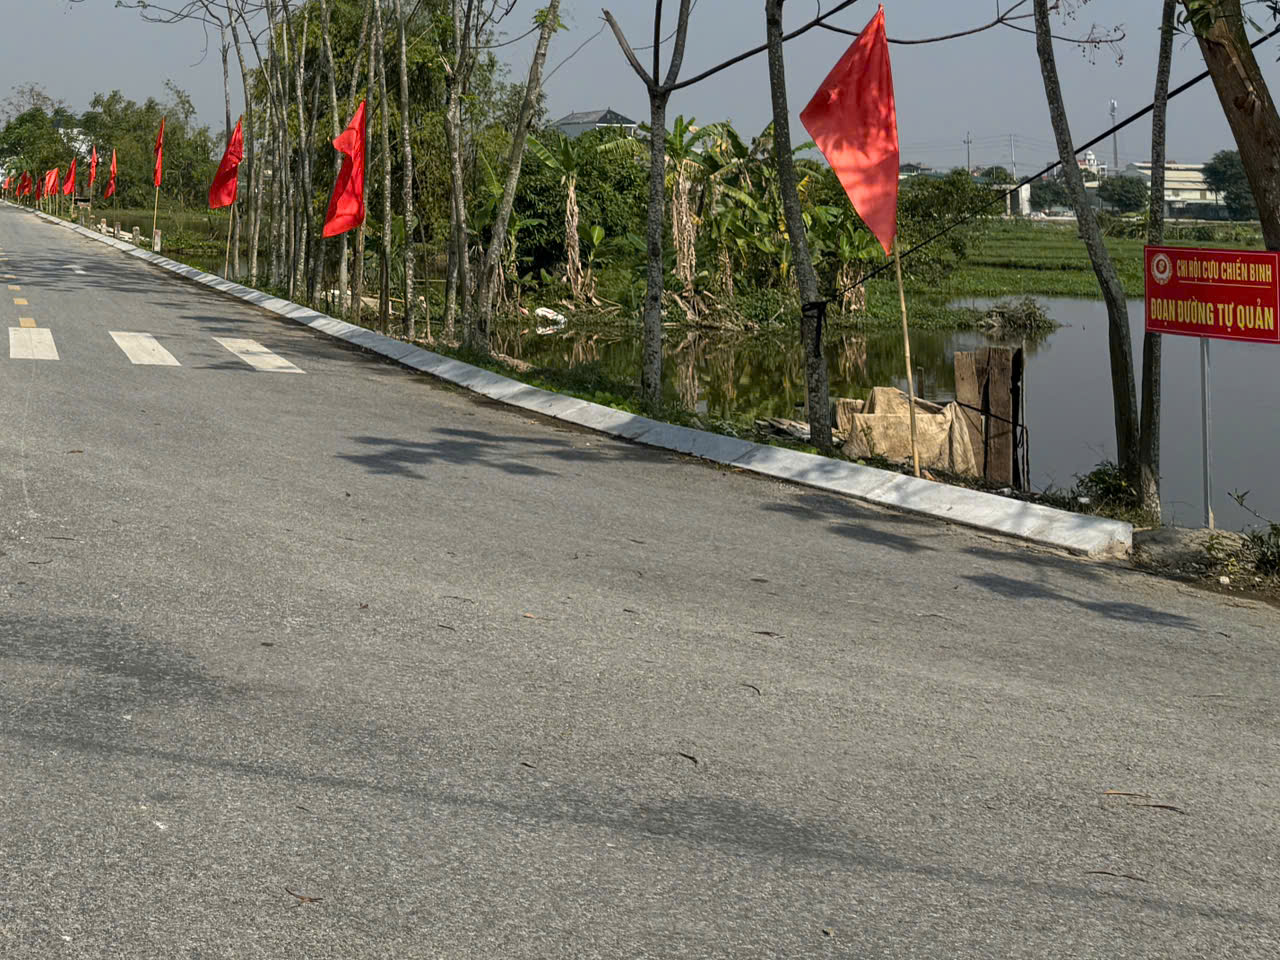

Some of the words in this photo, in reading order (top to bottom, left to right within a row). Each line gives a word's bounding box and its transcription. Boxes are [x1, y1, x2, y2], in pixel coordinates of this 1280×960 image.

[1221, 257, 1248, 281] CHIẾN
[1249, 263, 1272, 282] BINH
[1151, 298, 1176, 326] ĐOẠN
[1177, 296, 1215, 326] ĐƯỜNG
[1217, 301, 1234, 332] TỰ
[1236, 298, 1274, 331] QUẢN
